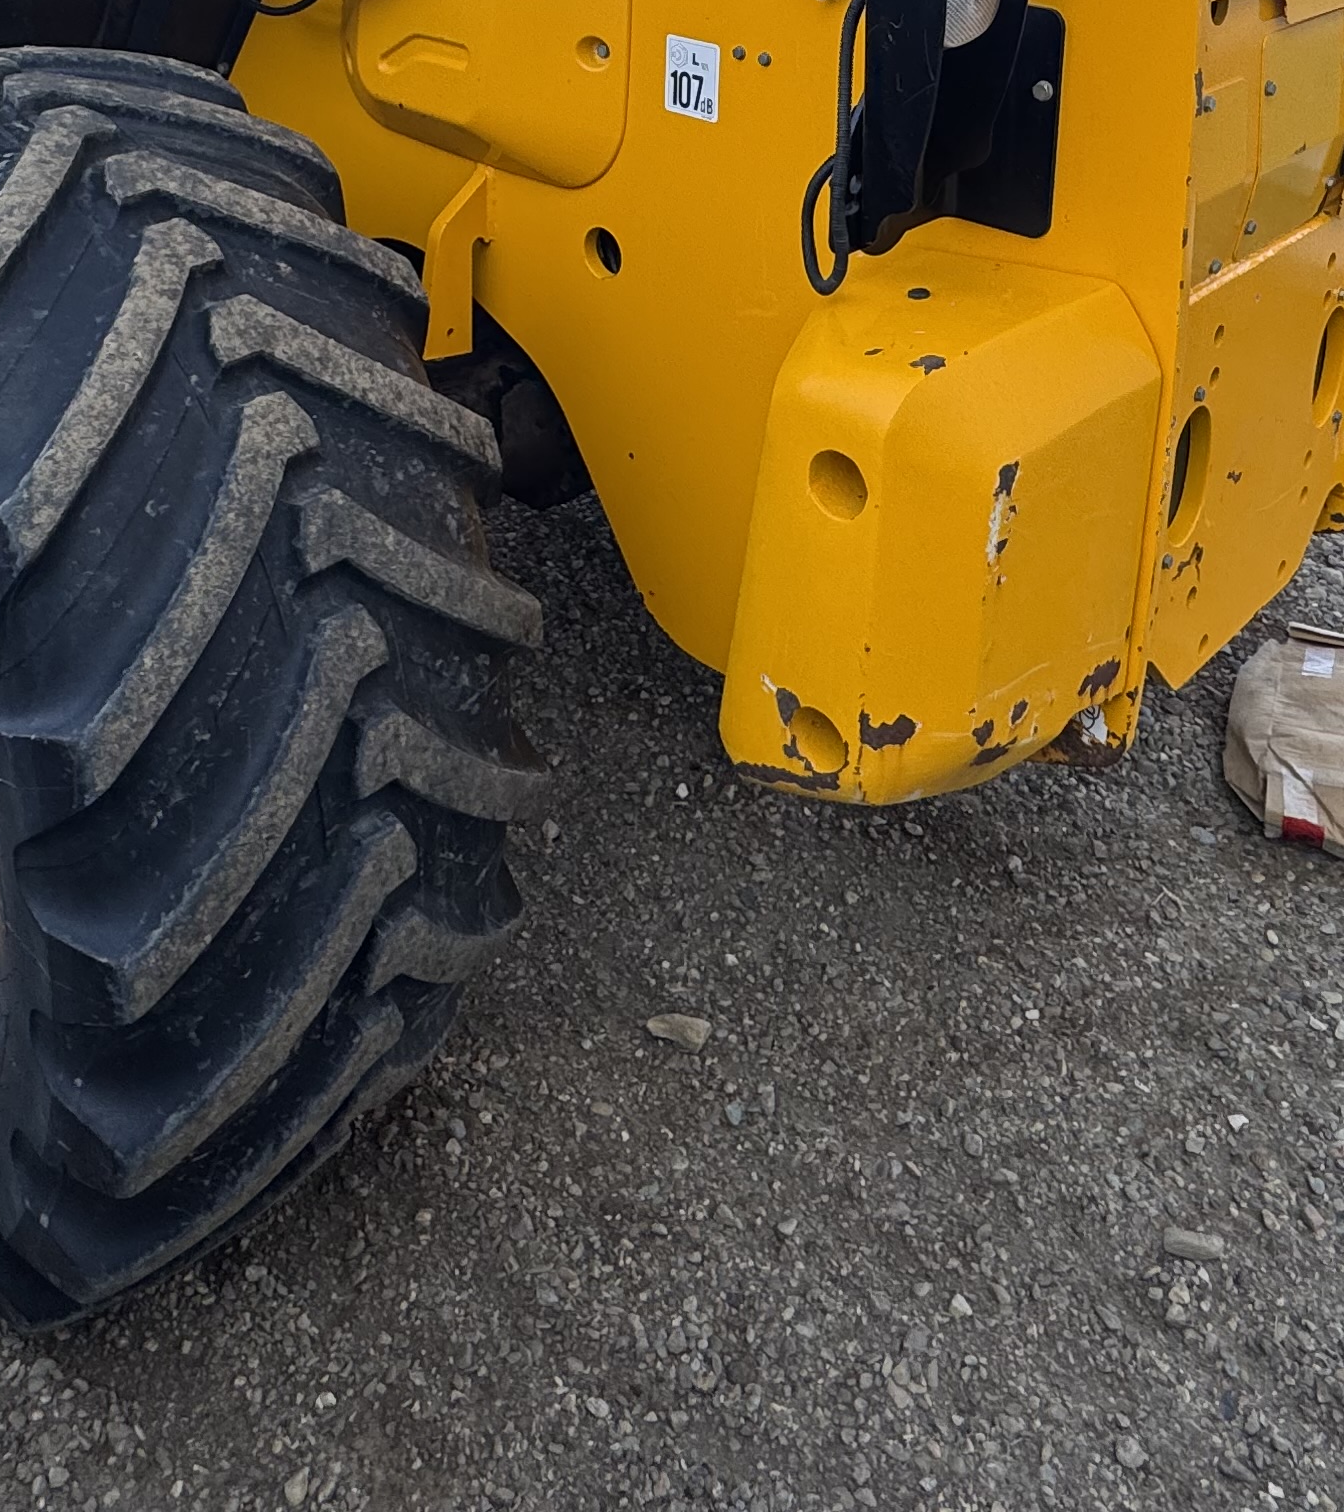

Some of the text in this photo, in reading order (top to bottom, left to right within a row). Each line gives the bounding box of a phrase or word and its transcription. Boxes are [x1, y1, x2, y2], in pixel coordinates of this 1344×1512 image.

[692, 52, 700, 66] L
[670, 69, 714, 115] 107 dB
